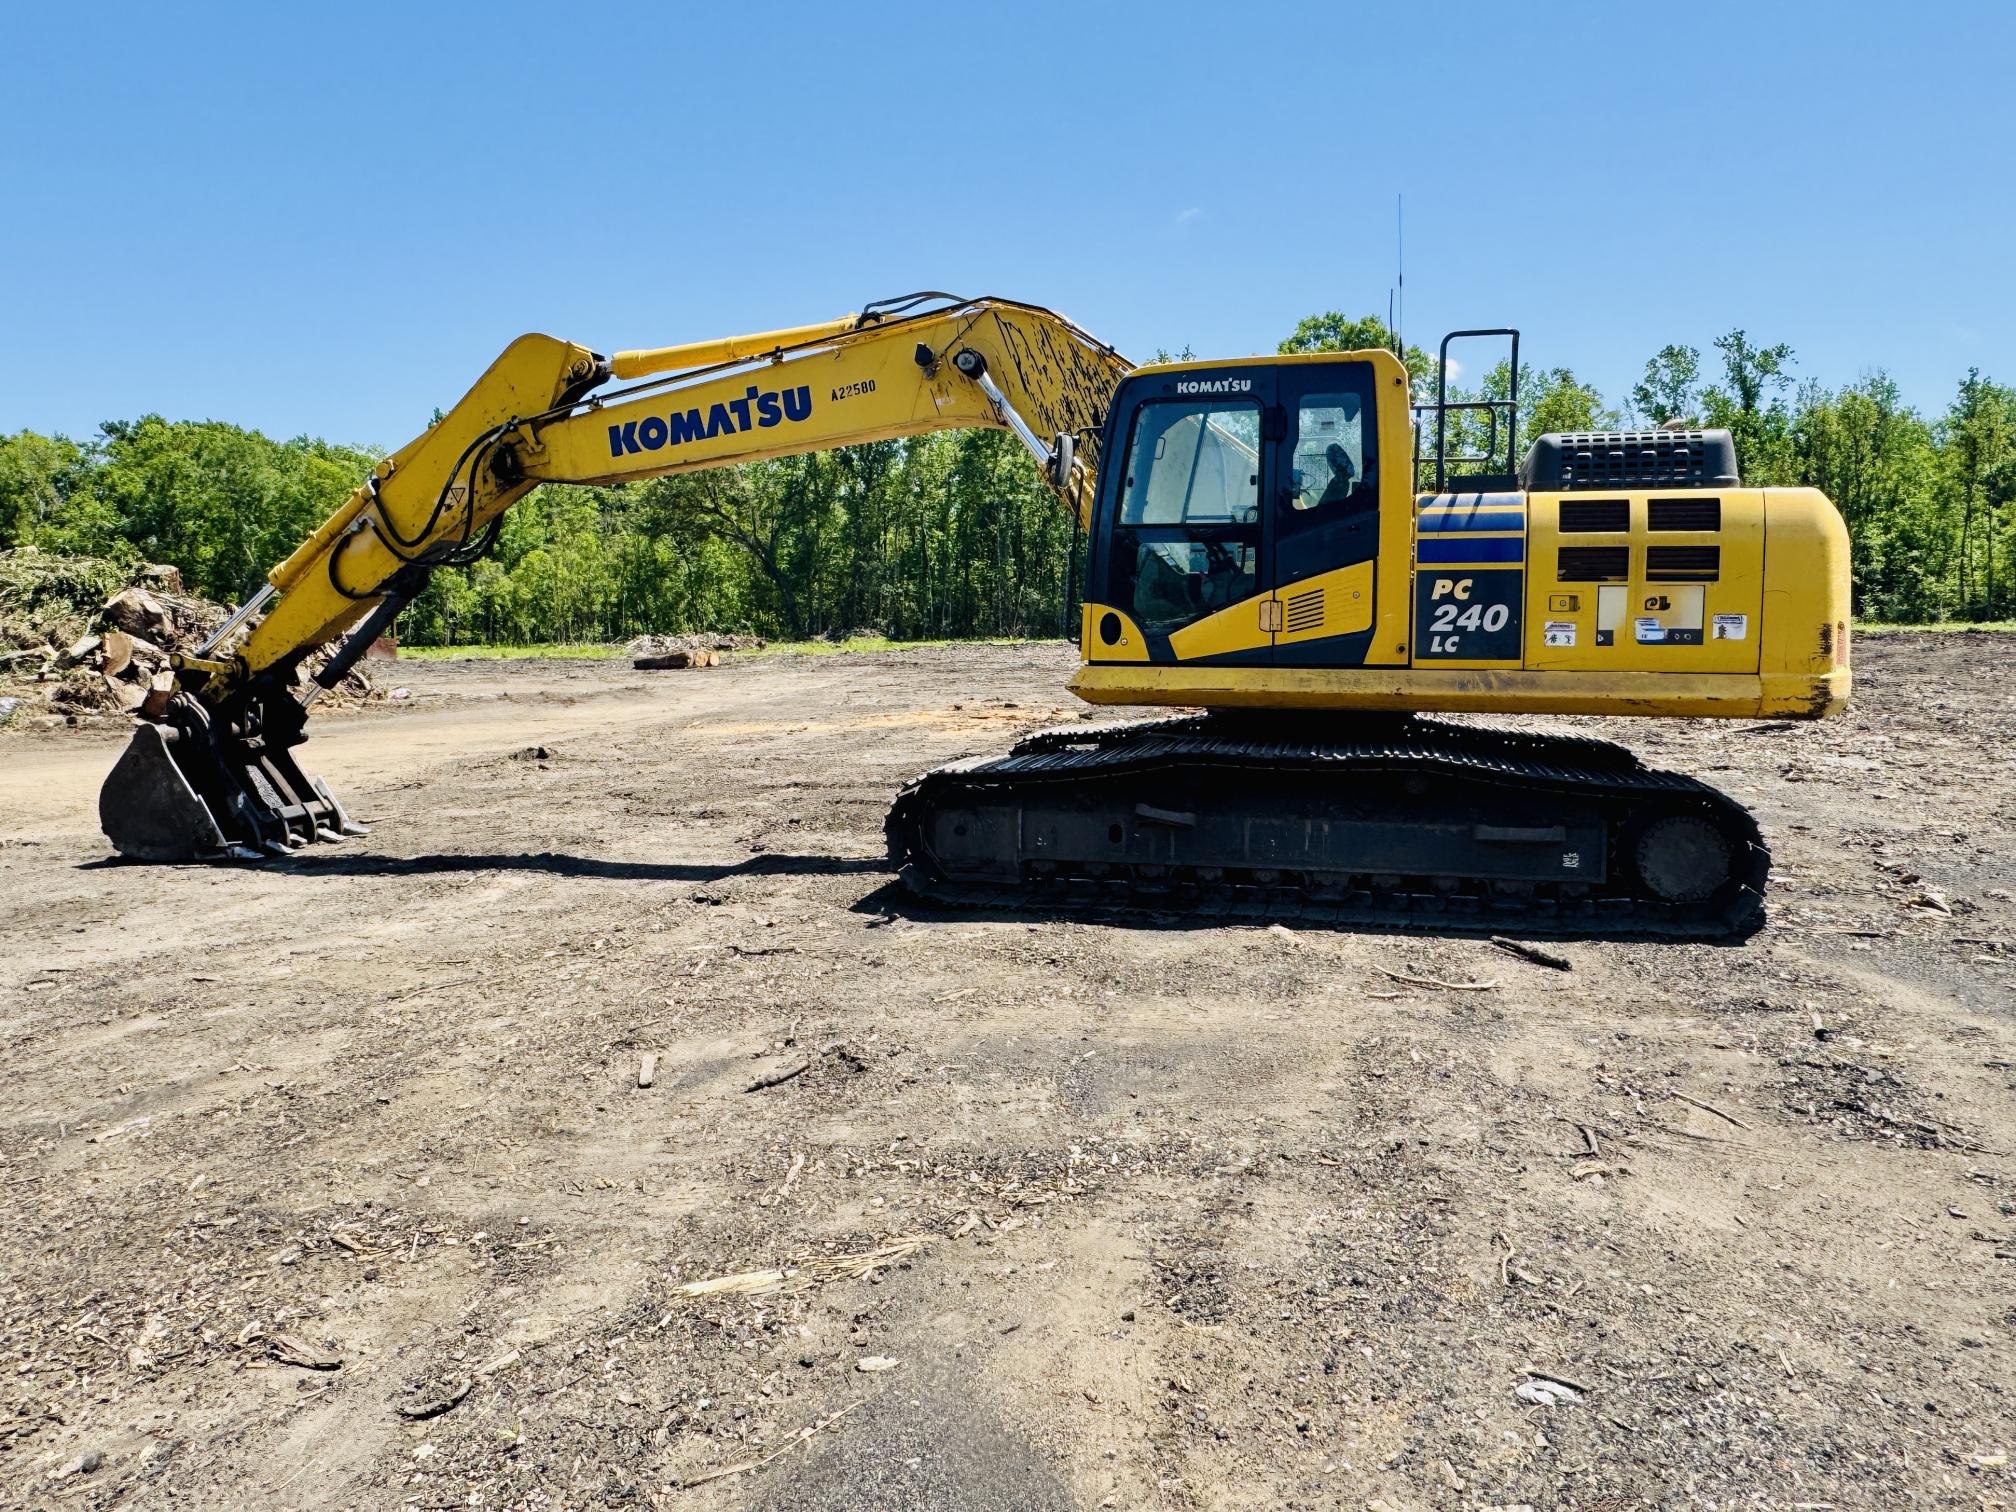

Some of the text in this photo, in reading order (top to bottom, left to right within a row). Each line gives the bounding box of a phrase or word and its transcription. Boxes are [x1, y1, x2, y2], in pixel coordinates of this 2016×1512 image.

[831, 379, 876, 402] A22580
[1177, 377, 1252, 394] KOMATSU
[608, 385, 813, 457] KOMATSU
[1431, 579, 1473, 600] PC
[1429, 604, 1509, 632] 240
[1430, 636, 1460, 653] LC
